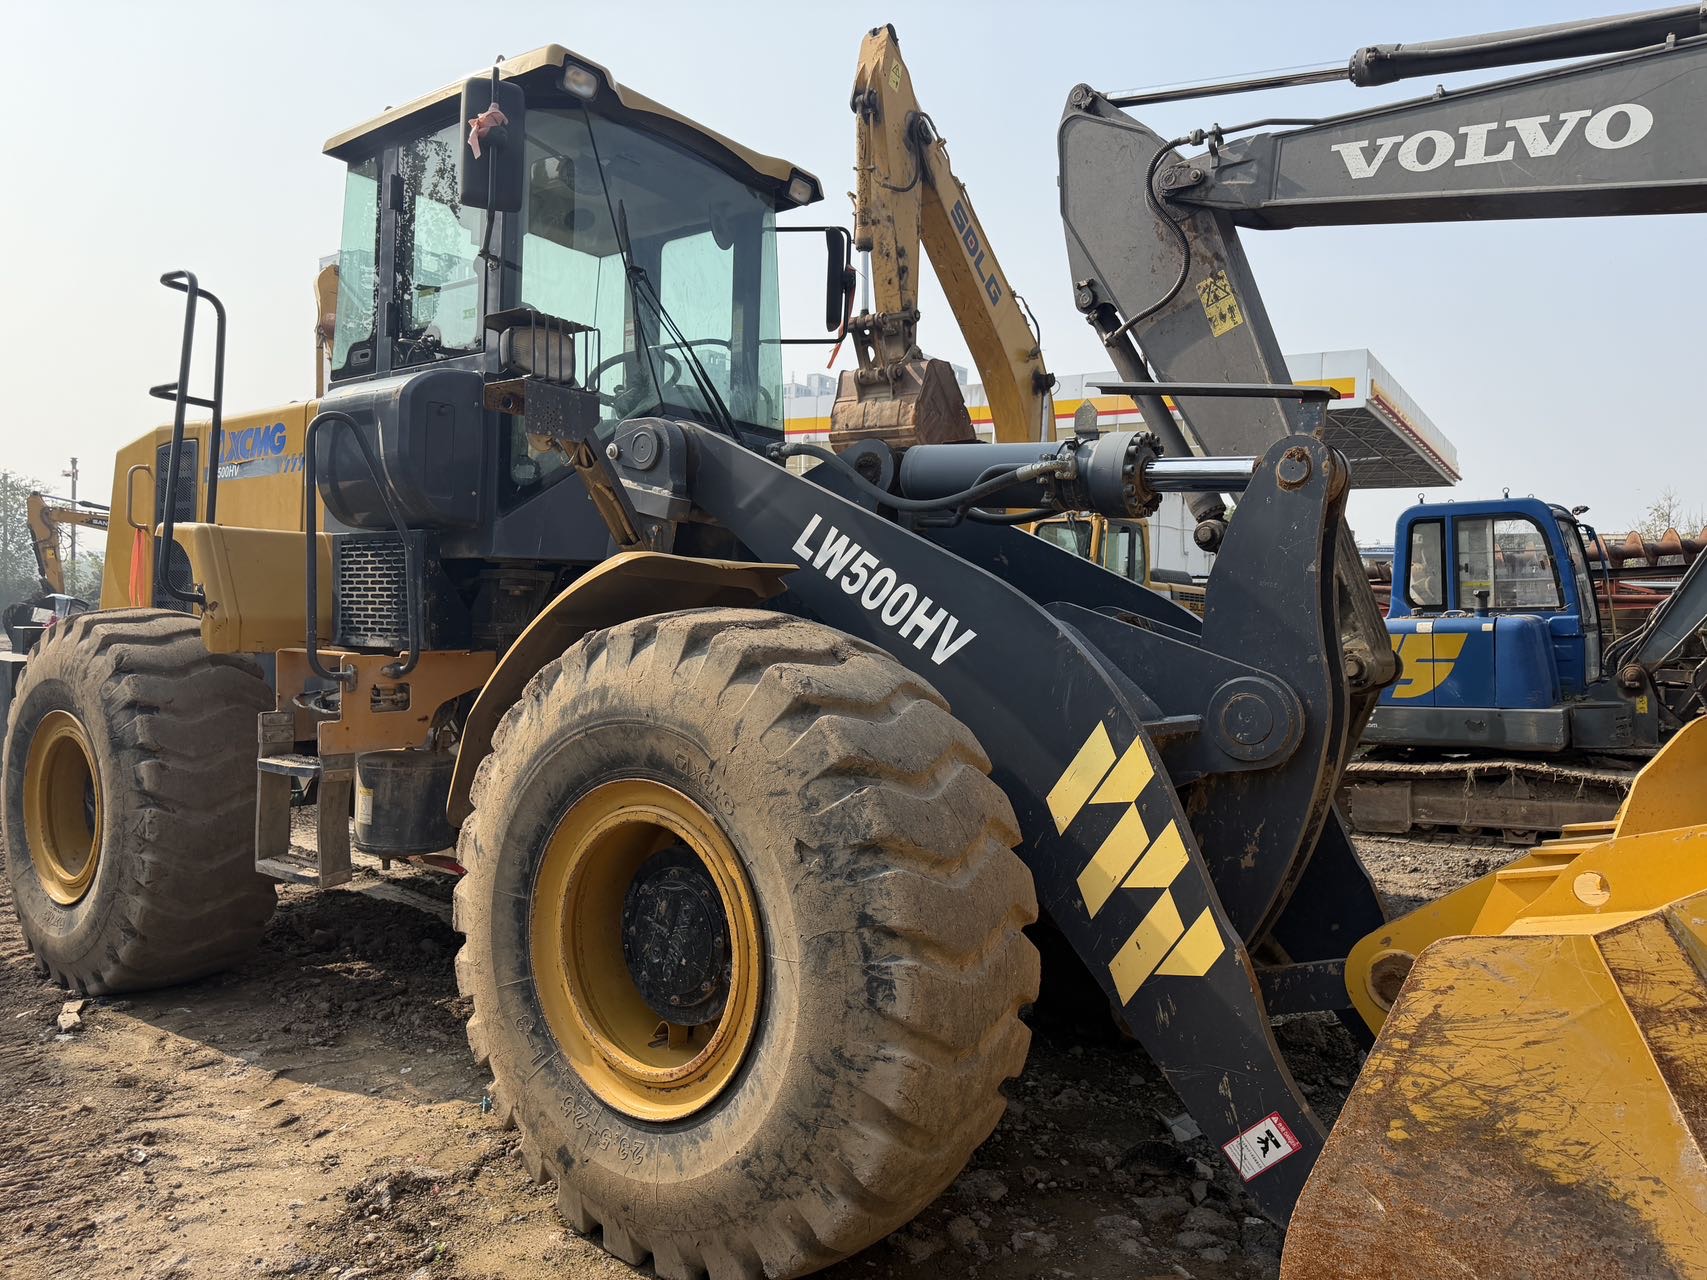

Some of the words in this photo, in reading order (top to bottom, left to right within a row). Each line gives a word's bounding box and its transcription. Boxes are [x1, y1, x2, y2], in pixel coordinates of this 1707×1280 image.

[1331, 103, 1654, 179] VOLVO
[951, 199, 1002, 306] SDLG
[217, 464, 240, 479] 500HV
[225, 422, 287, 463] XCMG
[92, 519, 108, 527] SAN
[792, 513, 978, 666] LW500HV
[562, 1094, 647, 1166] 23.5-25
